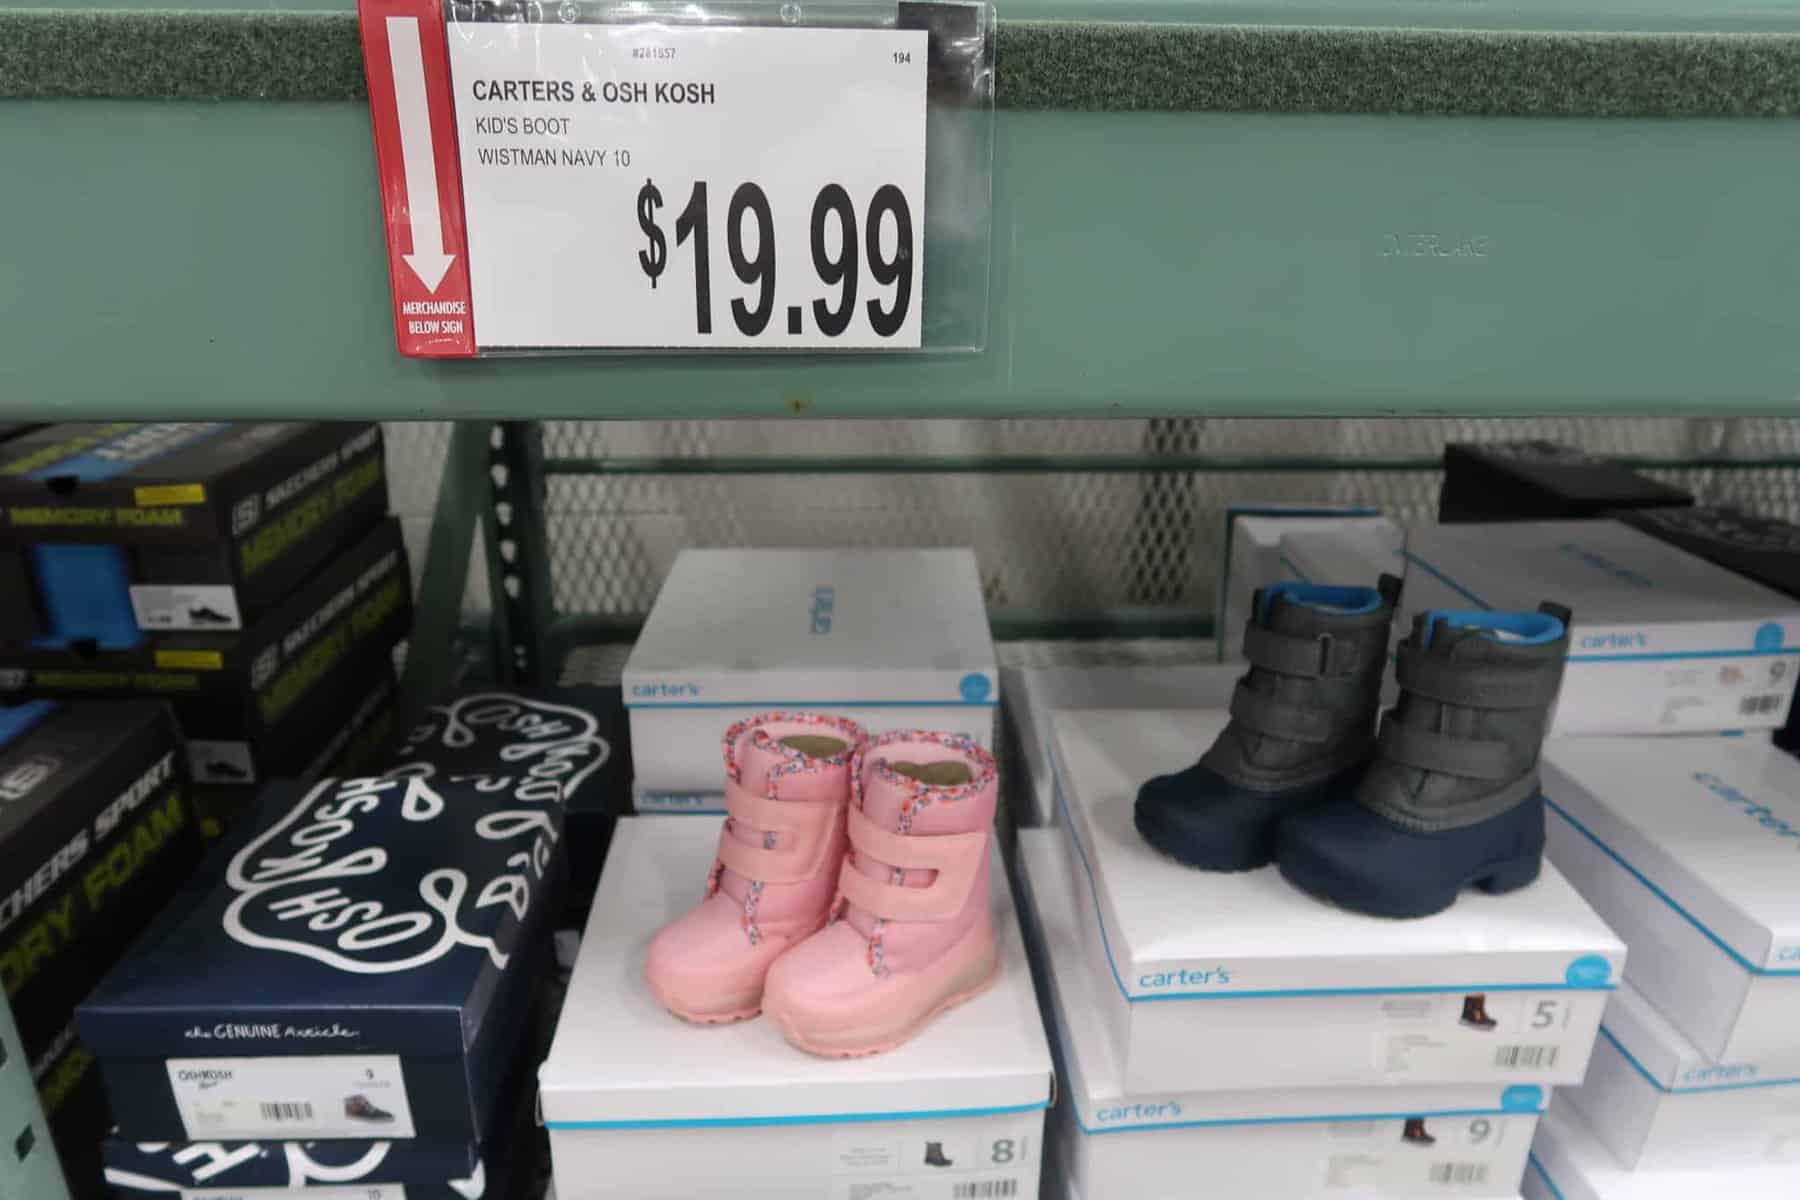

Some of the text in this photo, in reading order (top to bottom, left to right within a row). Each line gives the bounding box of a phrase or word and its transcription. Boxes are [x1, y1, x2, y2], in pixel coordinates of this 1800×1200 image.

[893, 51, 911, 65] 194
[473, 80, 715, 104] CARTERS & OSH KOSH
[475, 117, 570, 135] KID'S BOOT
[478, 147, 631, 167] WISTMAN NAVY 10
[637, 178, 914, 337] $19.99
[402, 301, 467, 315] MERCHANDISE
[408, 319, 464, 335] BELOW SIGN
[1138, 964, 1231, 989] carter's
[1531, 1001, 1557, 1029] 5
[214, 1023, 281, 1039] GENUINE
[1096, 1100, 1183, 1122] carter's
[1469, 1118, 1491, 1144] 9
[991, 1138, 1015, 1164] 8
